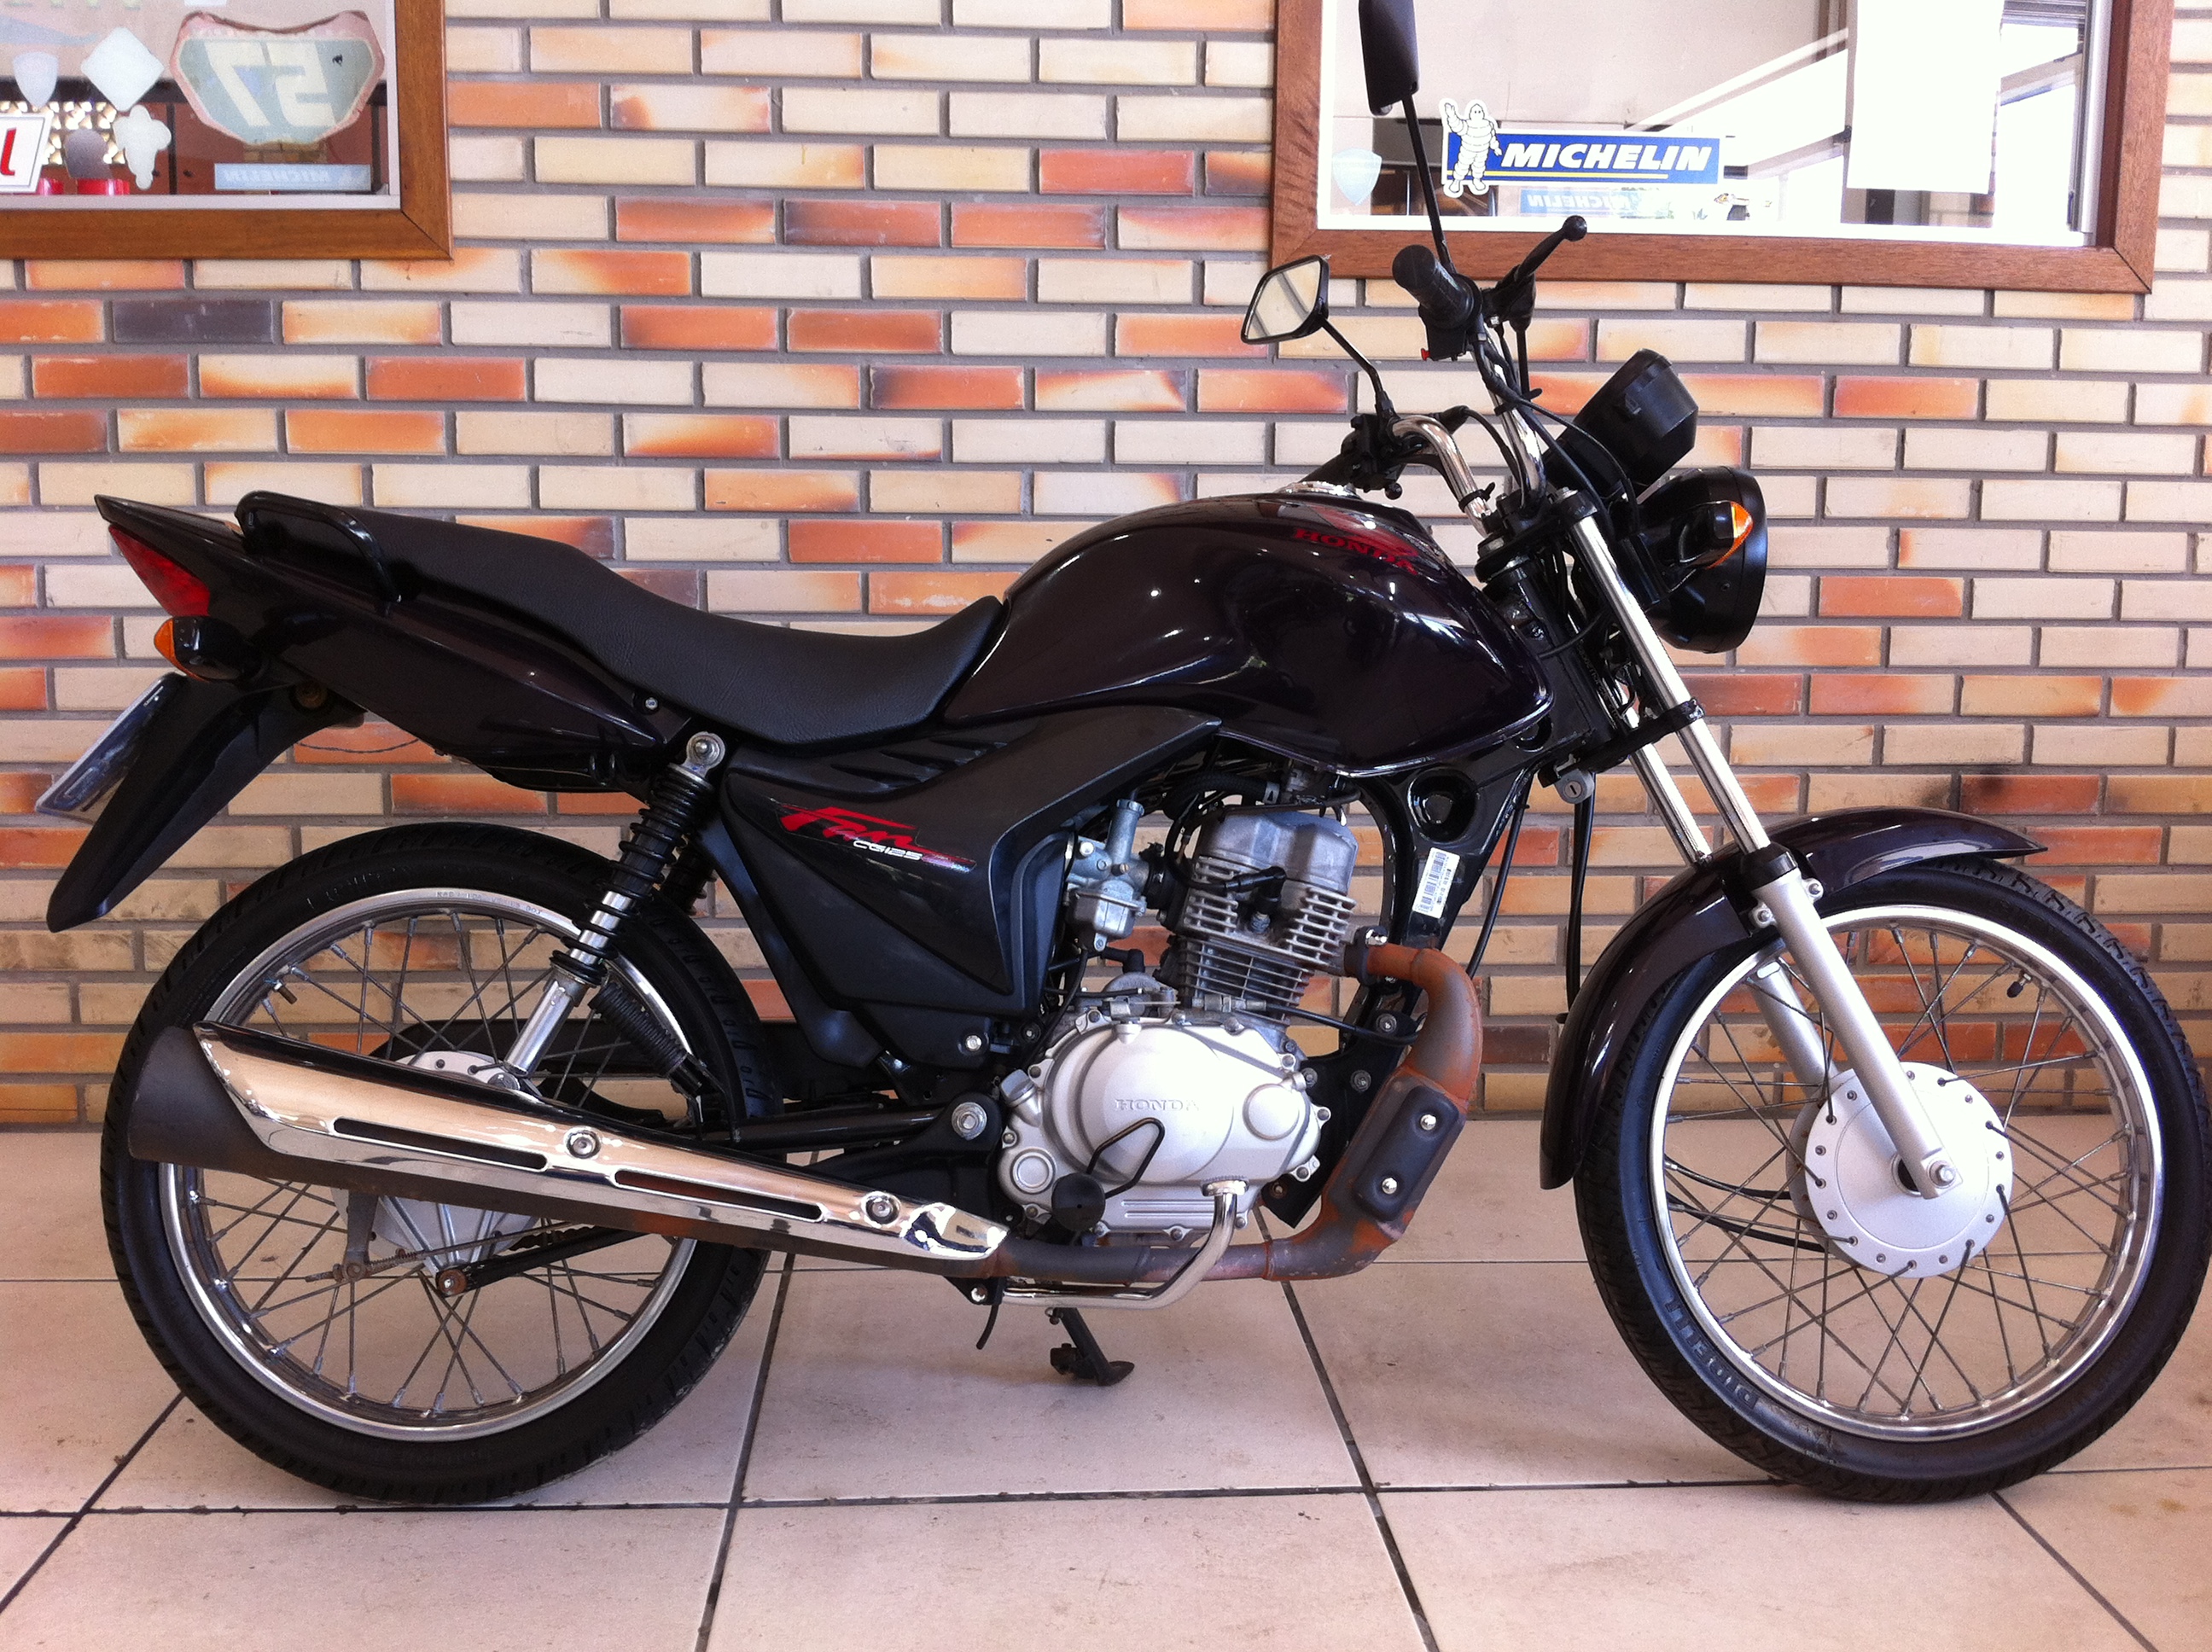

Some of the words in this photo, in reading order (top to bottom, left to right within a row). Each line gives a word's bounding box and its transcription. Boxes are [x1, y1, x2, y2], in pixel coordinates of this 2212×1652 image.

[1500, 143, 1712, 172] MICHELIN
[1295, 528, 1419, 575] HONDA
[1115, 1098, 1200, 1111] HONDA
